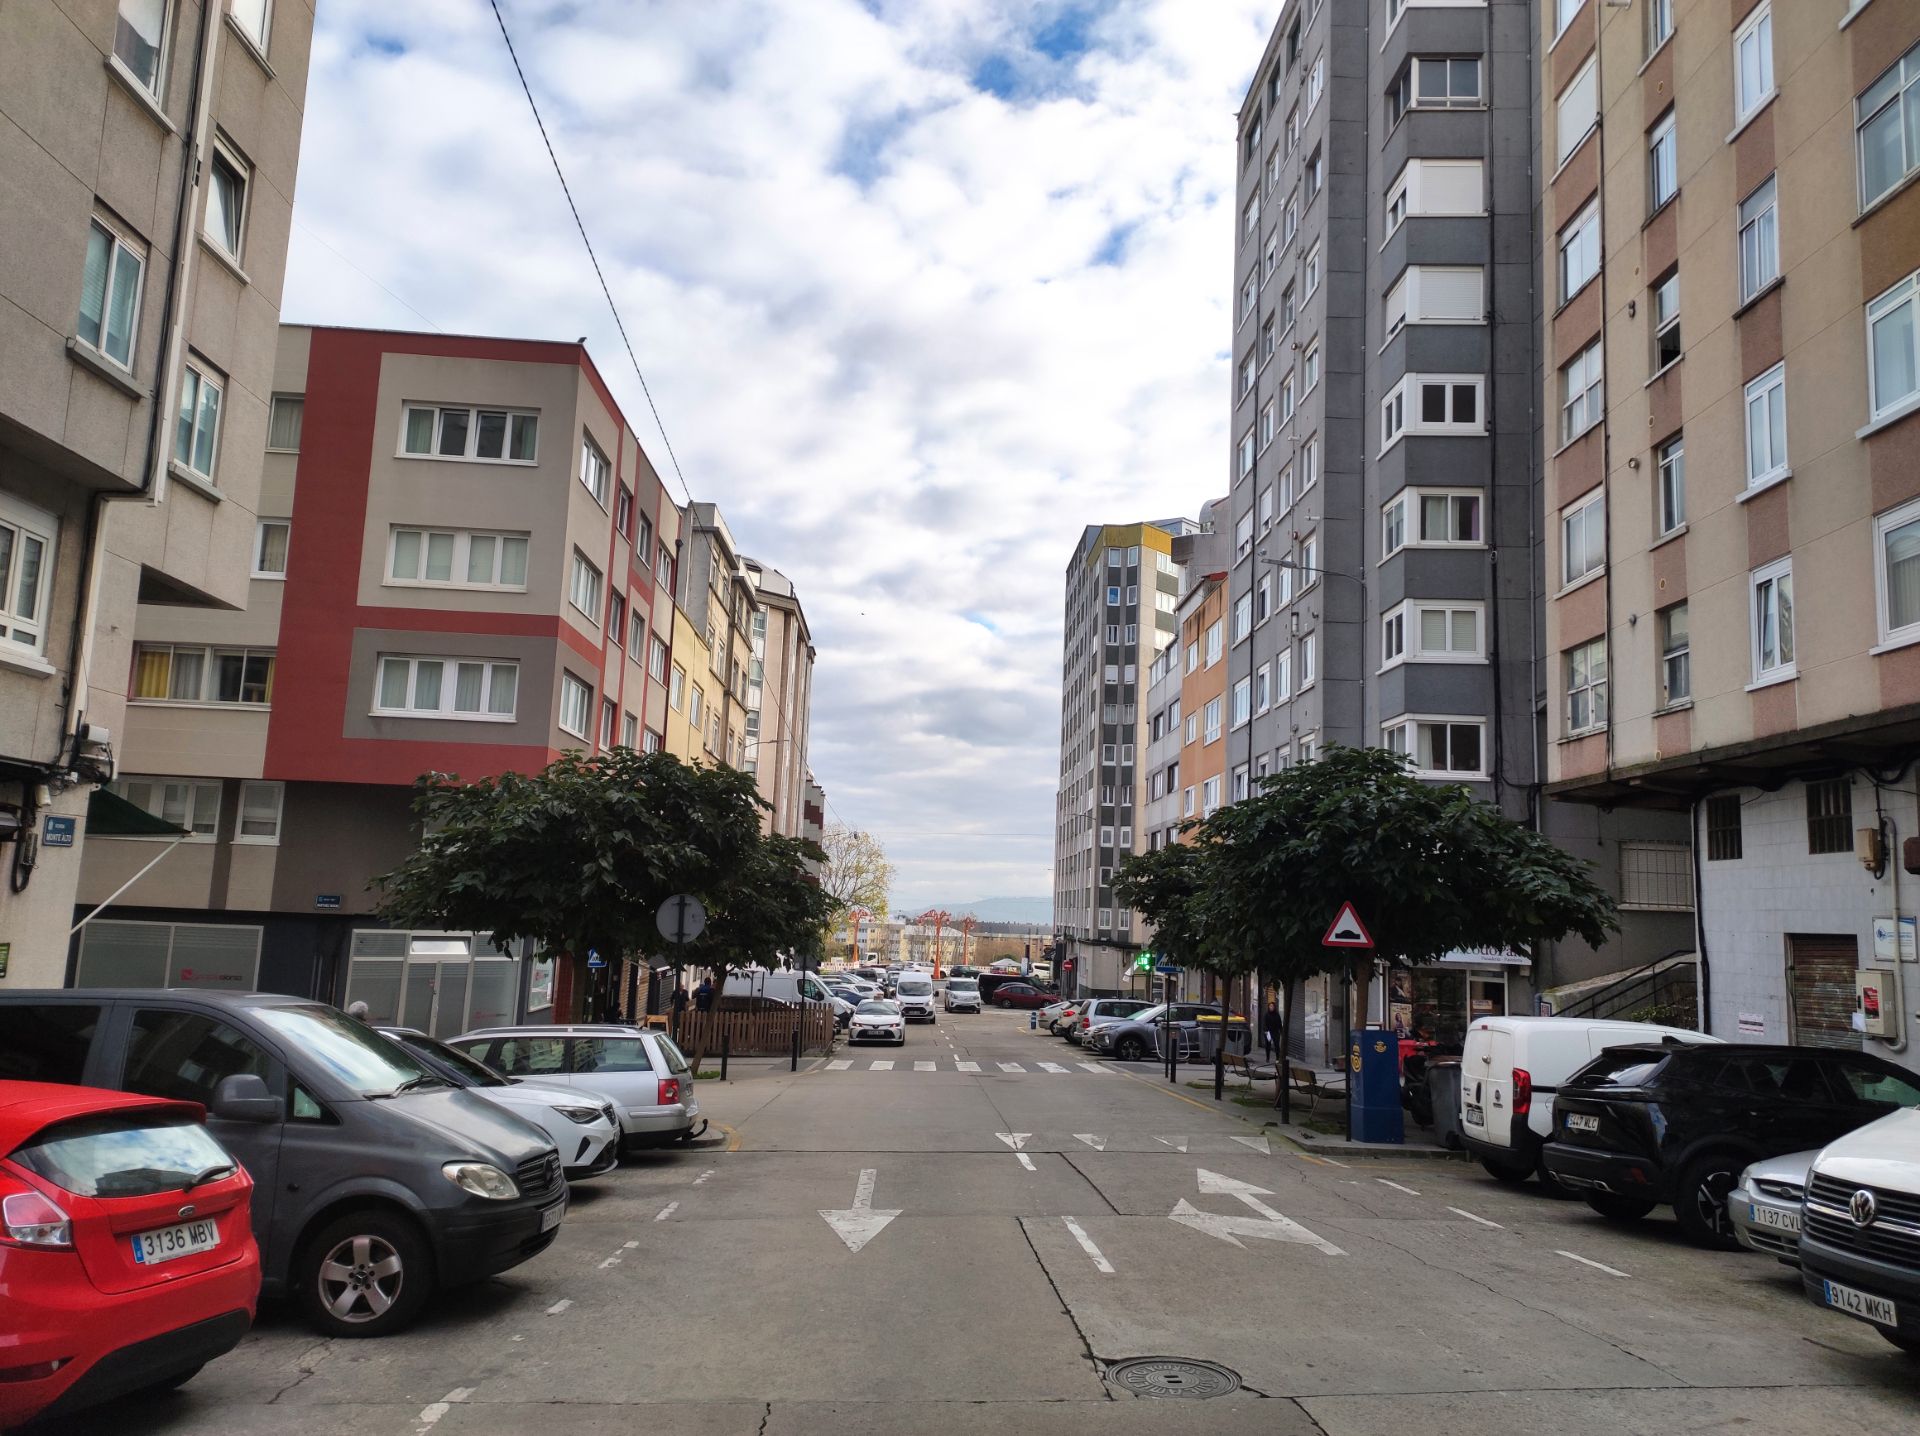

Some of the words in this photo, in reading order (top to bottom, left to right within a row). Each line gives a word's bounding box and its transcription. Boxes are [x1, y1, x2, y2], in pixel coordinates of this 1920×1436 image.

[46, 833, 61, 841] MONTE
[61, 834, 72, 842] ALTO
[1757, 1207, 1780, 1226] 1137
[1781, 1214, 1801, 1231] CVL
[144, 1228, 186, 1257] 3136
[188, 1221, 214, 1246] MBV
[1831, 1286, 1862, 1313] 9142
[1864, 1296, 1892, 1323] MKH
